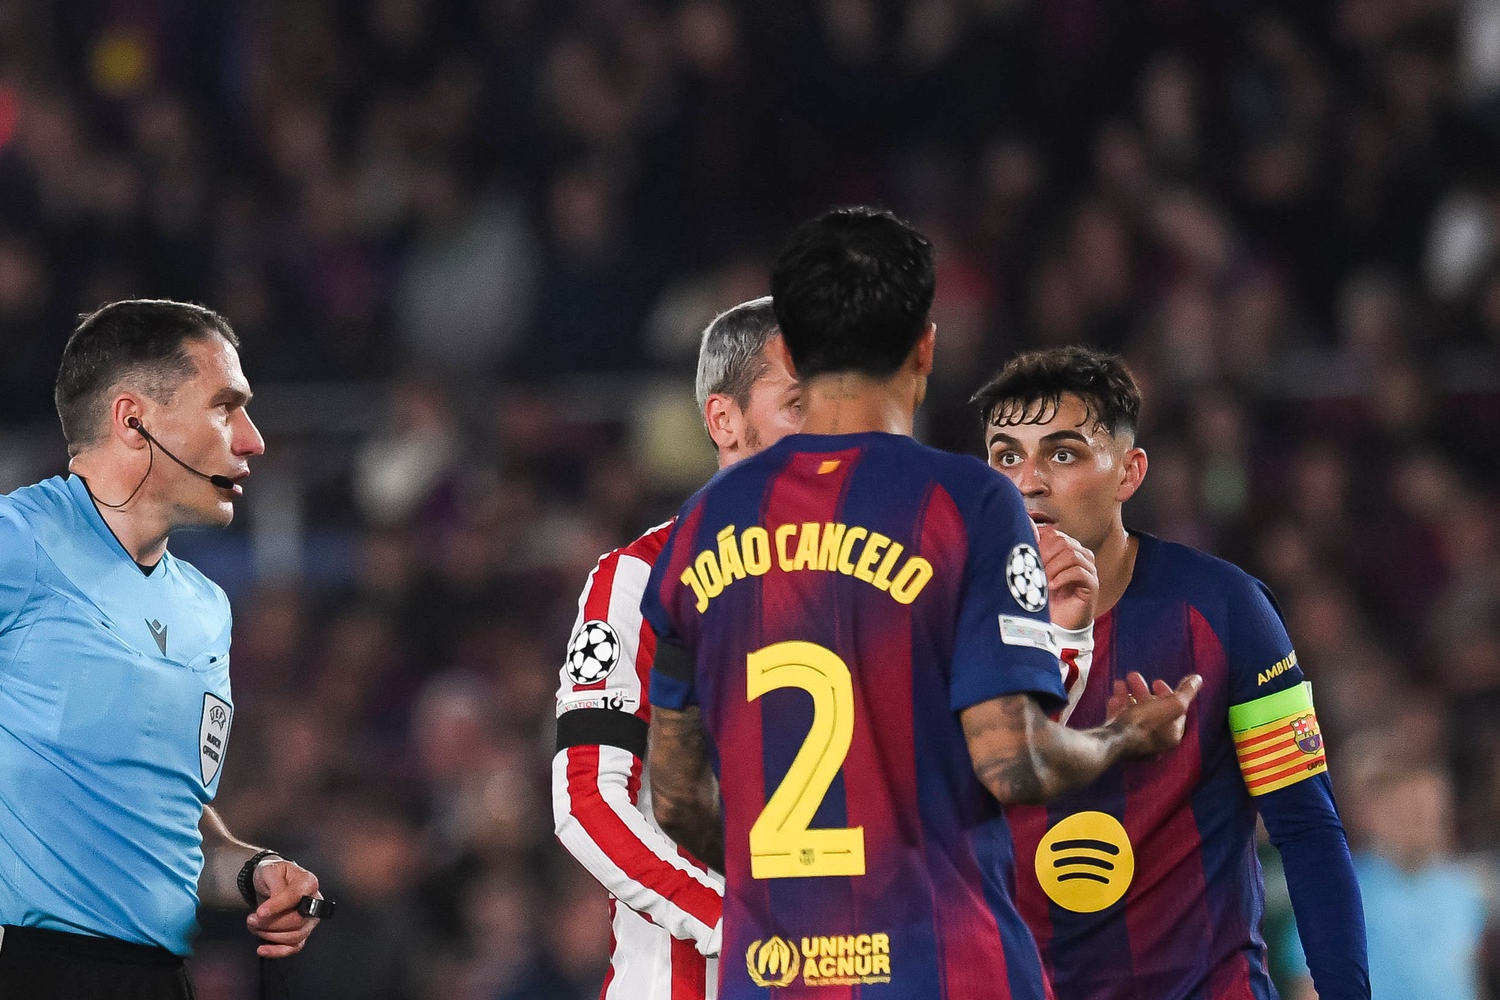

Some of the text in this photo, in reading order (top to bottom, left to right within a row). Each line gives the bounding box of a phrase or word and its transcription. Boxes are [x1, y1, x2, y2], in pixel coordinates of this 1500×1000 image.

[775, 522, 933, 605] CANCELO
[1257, 650, 1298, 686] AMBIL
[746, 641, 866, 879] 2
[801, 933, 890, 958] UNHCR
[803, 954, 891, 977] ACNUR
